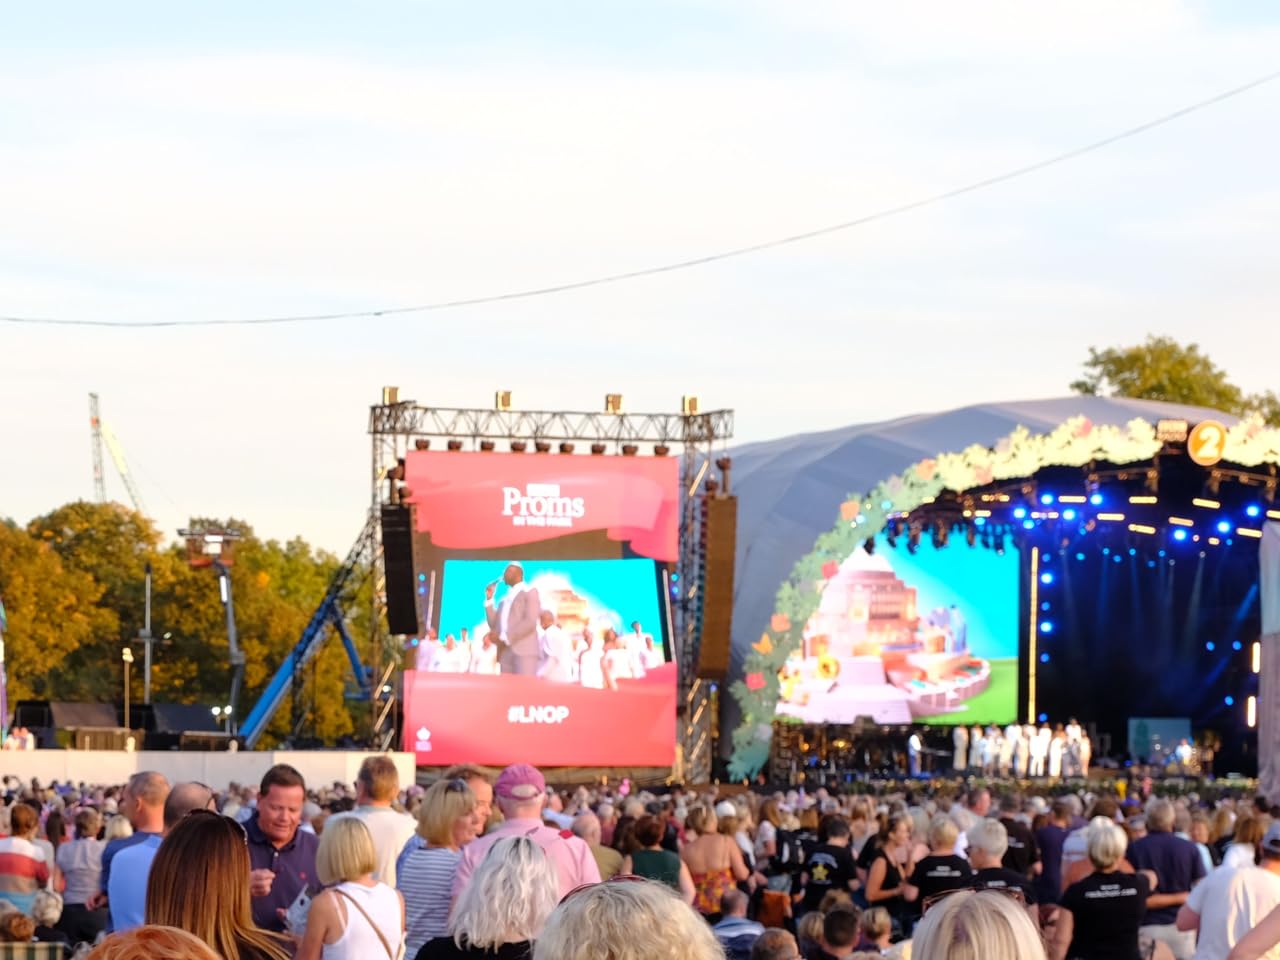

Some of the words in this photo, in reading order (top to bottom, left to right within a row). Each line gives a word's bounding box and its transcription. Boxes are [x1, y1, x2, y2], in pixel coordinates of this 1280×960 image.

[1196, 426, 1220, 458] 2
[502, 486, 585, 518] Proms
[507, 705, 570, 724] #LNOP
